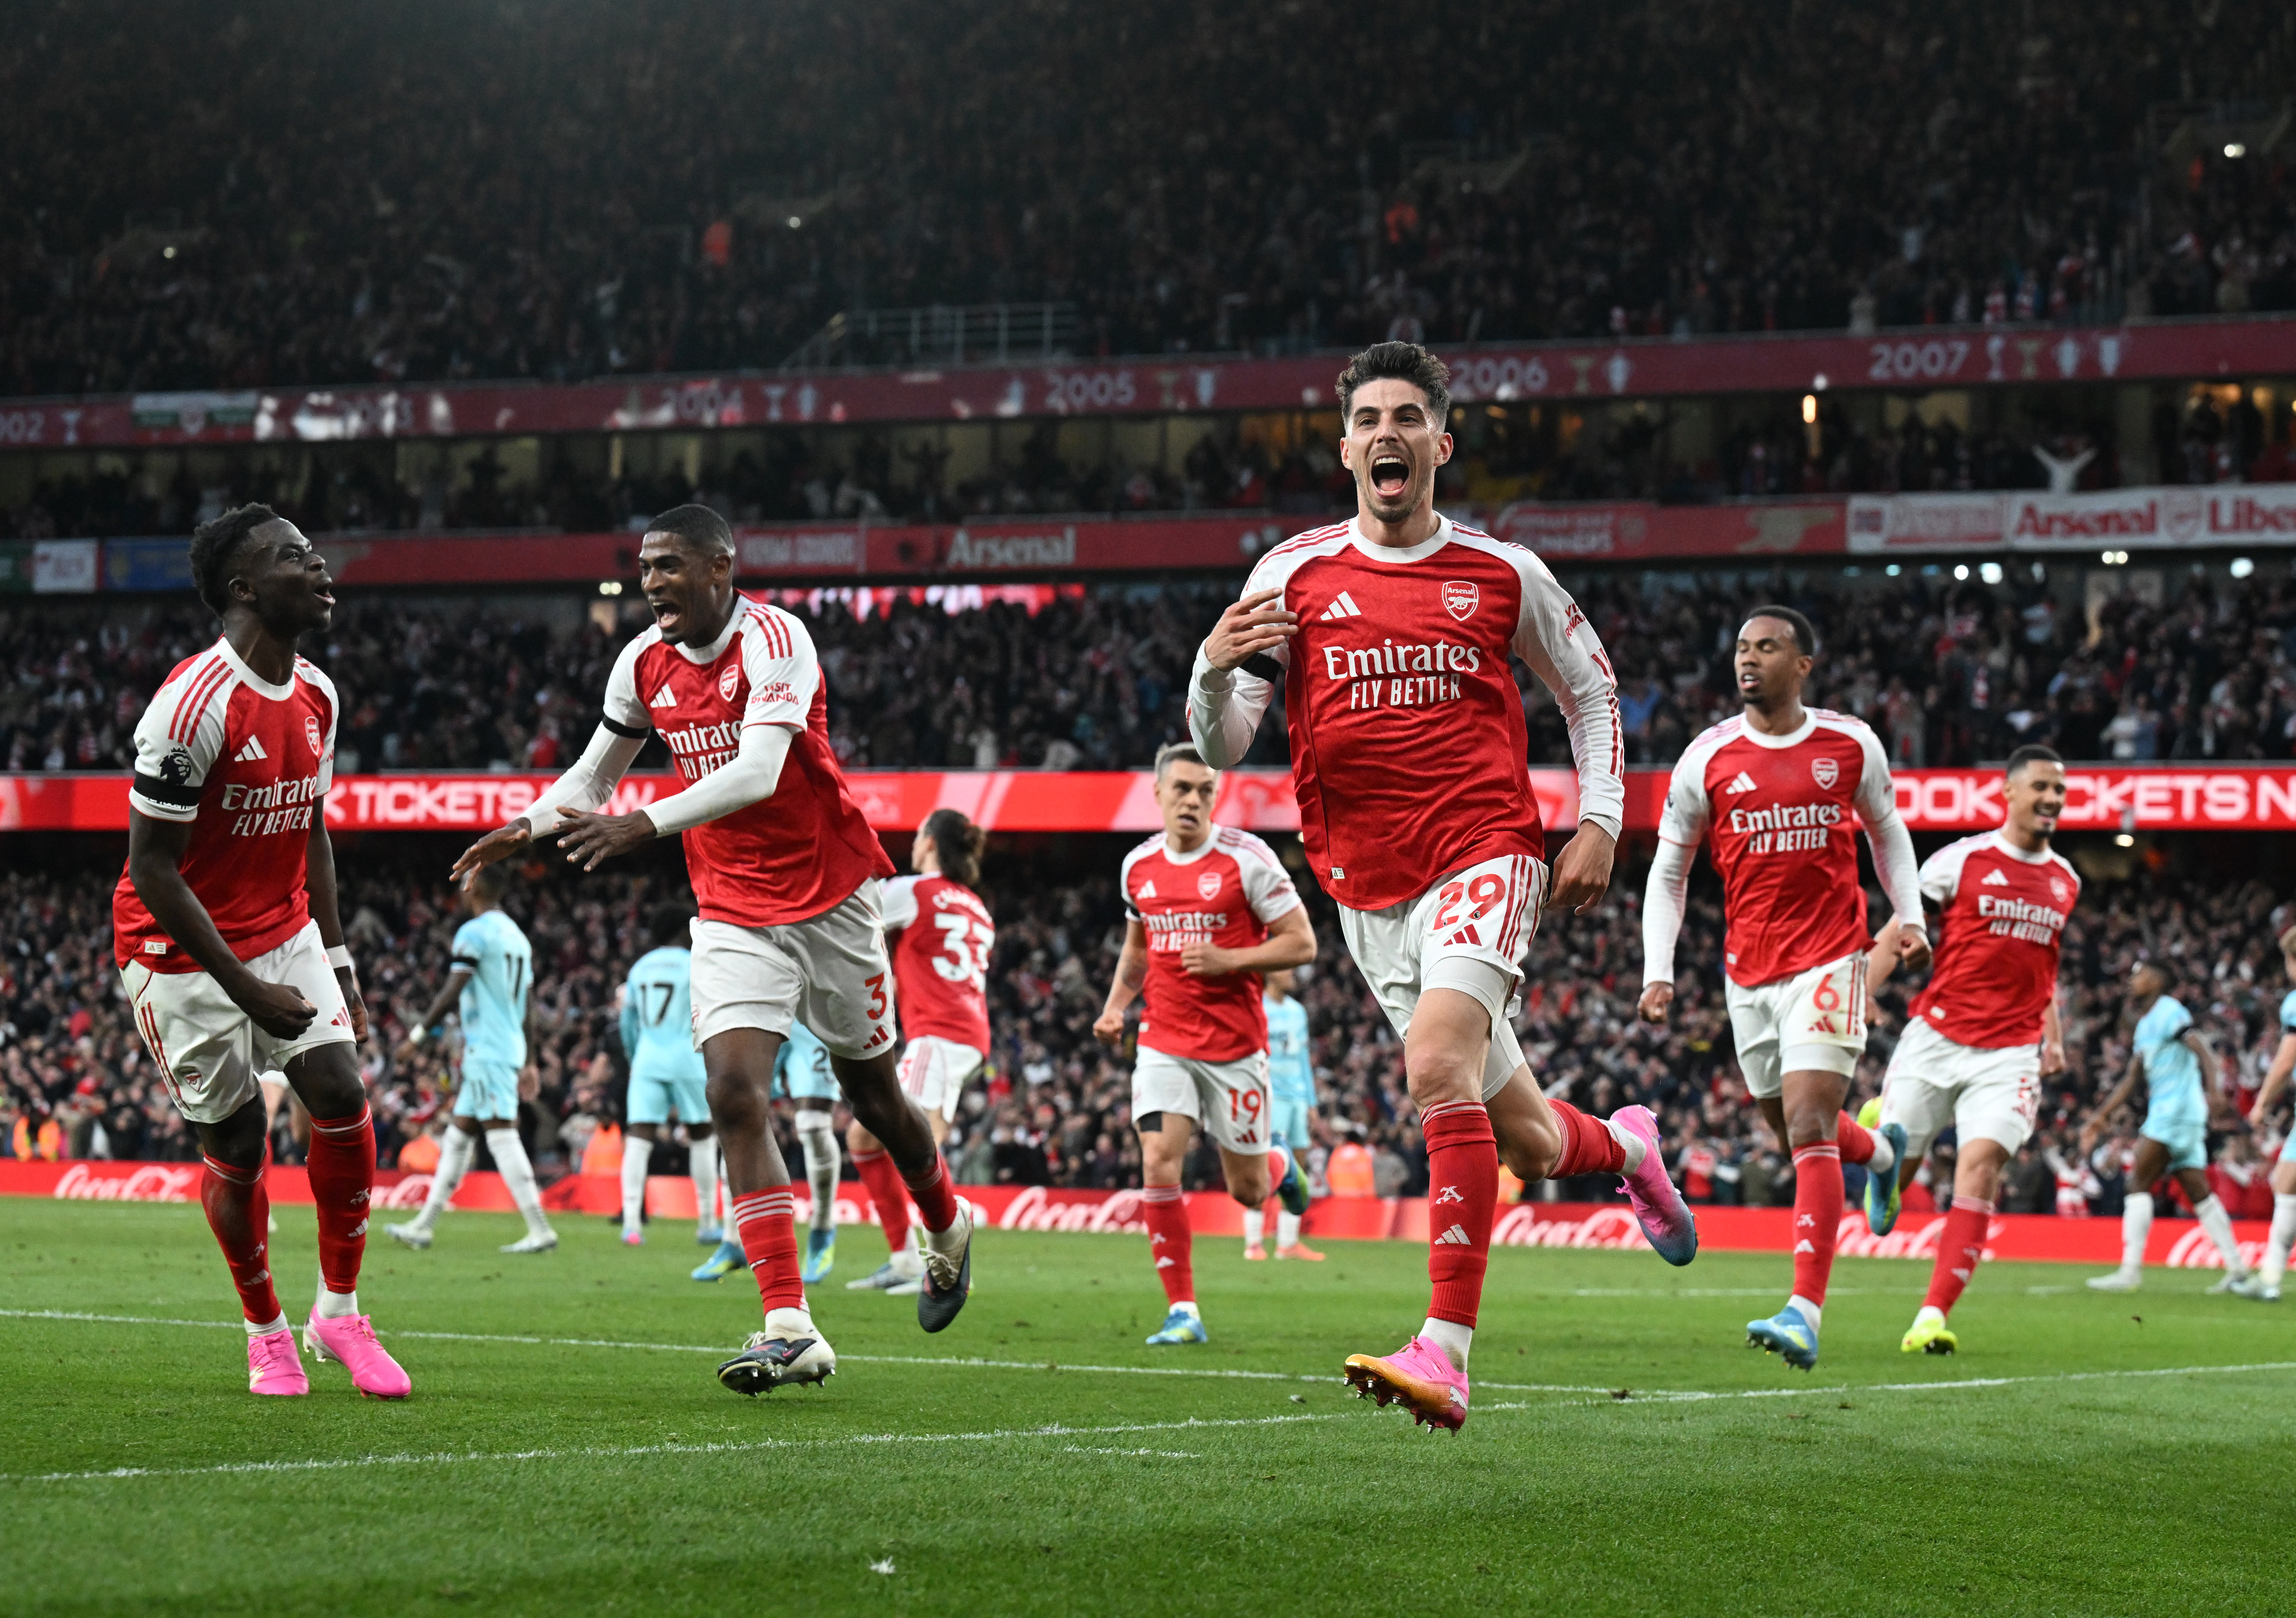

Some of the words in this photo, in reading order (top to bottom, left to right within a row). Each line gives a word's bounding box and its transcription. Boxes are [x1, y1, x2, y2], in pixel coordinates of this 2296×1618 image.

[1452, 358, 1549, 396] 2006
[1870, 341, 1969, 379] 2007
[1046, 371, 1136, 408] 2005
[0, 411, 45, 443] 02
[2016, 501, 2157, 536] Arsenal
[948, 528, 1076, 568] Arsenal
[1323, 638, 1480, 680] Emirates
[1350, 680, 1382, 710] FLY
[1390, 673, 1461, 706] BETTER
[222, 774, 318, 810] Emirate
[350, 781, 535, 824] TICKETS
[231, 813, 265, 836] FLY
[262, 806, 313, 835] BETTER
[1730, 802, 1841, 833] Emirates
[1749, 832, 1772, 854] FLY
[1776, 827, 1828, 853] BETTER
[1433, 873, 1506, 931] 29
[504, 952, 524, 1001] 11
[865, 971, 887, 1020] 3
[1813, 973, 1840, 1011] 6
[639, 983, 674, 1027] 17
[813, 1046, 836, 1084] 2
[1228, 1088, 1261, 1124] 19
